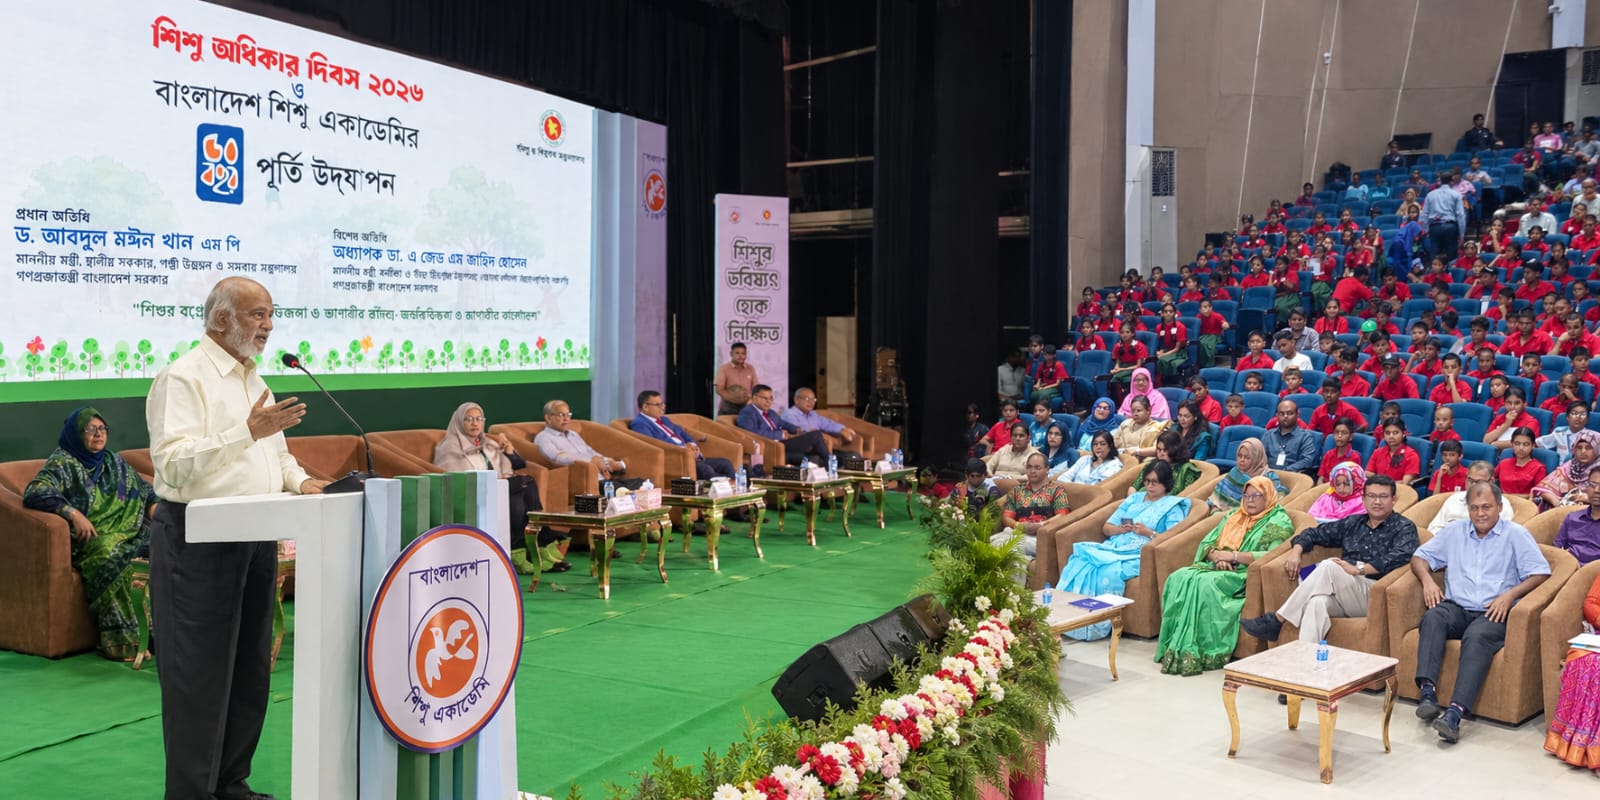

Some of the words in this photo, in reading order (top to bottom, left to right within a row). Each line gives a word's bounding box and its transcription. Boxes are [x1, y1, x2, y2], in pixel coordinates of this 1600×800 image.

[151, 15, 204, 62] শিশু
[212, 34, 299, 77] অধিকার
[306, 52, 359, 90] দিবস
[368, 73, 424, 103] ২০২৬
[291, 82, 304, 99] ও
[153, 79, 261, 118] বাংলাদেশ
[268, 91, 309, 130] শিশু
[319, 110, 419, 149] একাডেমির
[256, 151, 304, 192] পূর্তি
[15, 207, 49, 222] প্রধান
[13, 226, 36, 244] ড.
[40, 227, 107, 252] আবদুল
[113, 227, 155, 249] মঈন
[162, 233, 194, 251] খান
[201, 239, 222, 252] এম
[226, 235, 241, 253] পি
[332, 245, 384, 261] অধ্যাপক
[407, 250, 417, 263] এ
[733, 240, 773, 267] শিশুর
[736, 299, 769, 315] হোক
[419, 559, 479, 586] বাংলাদেশ
